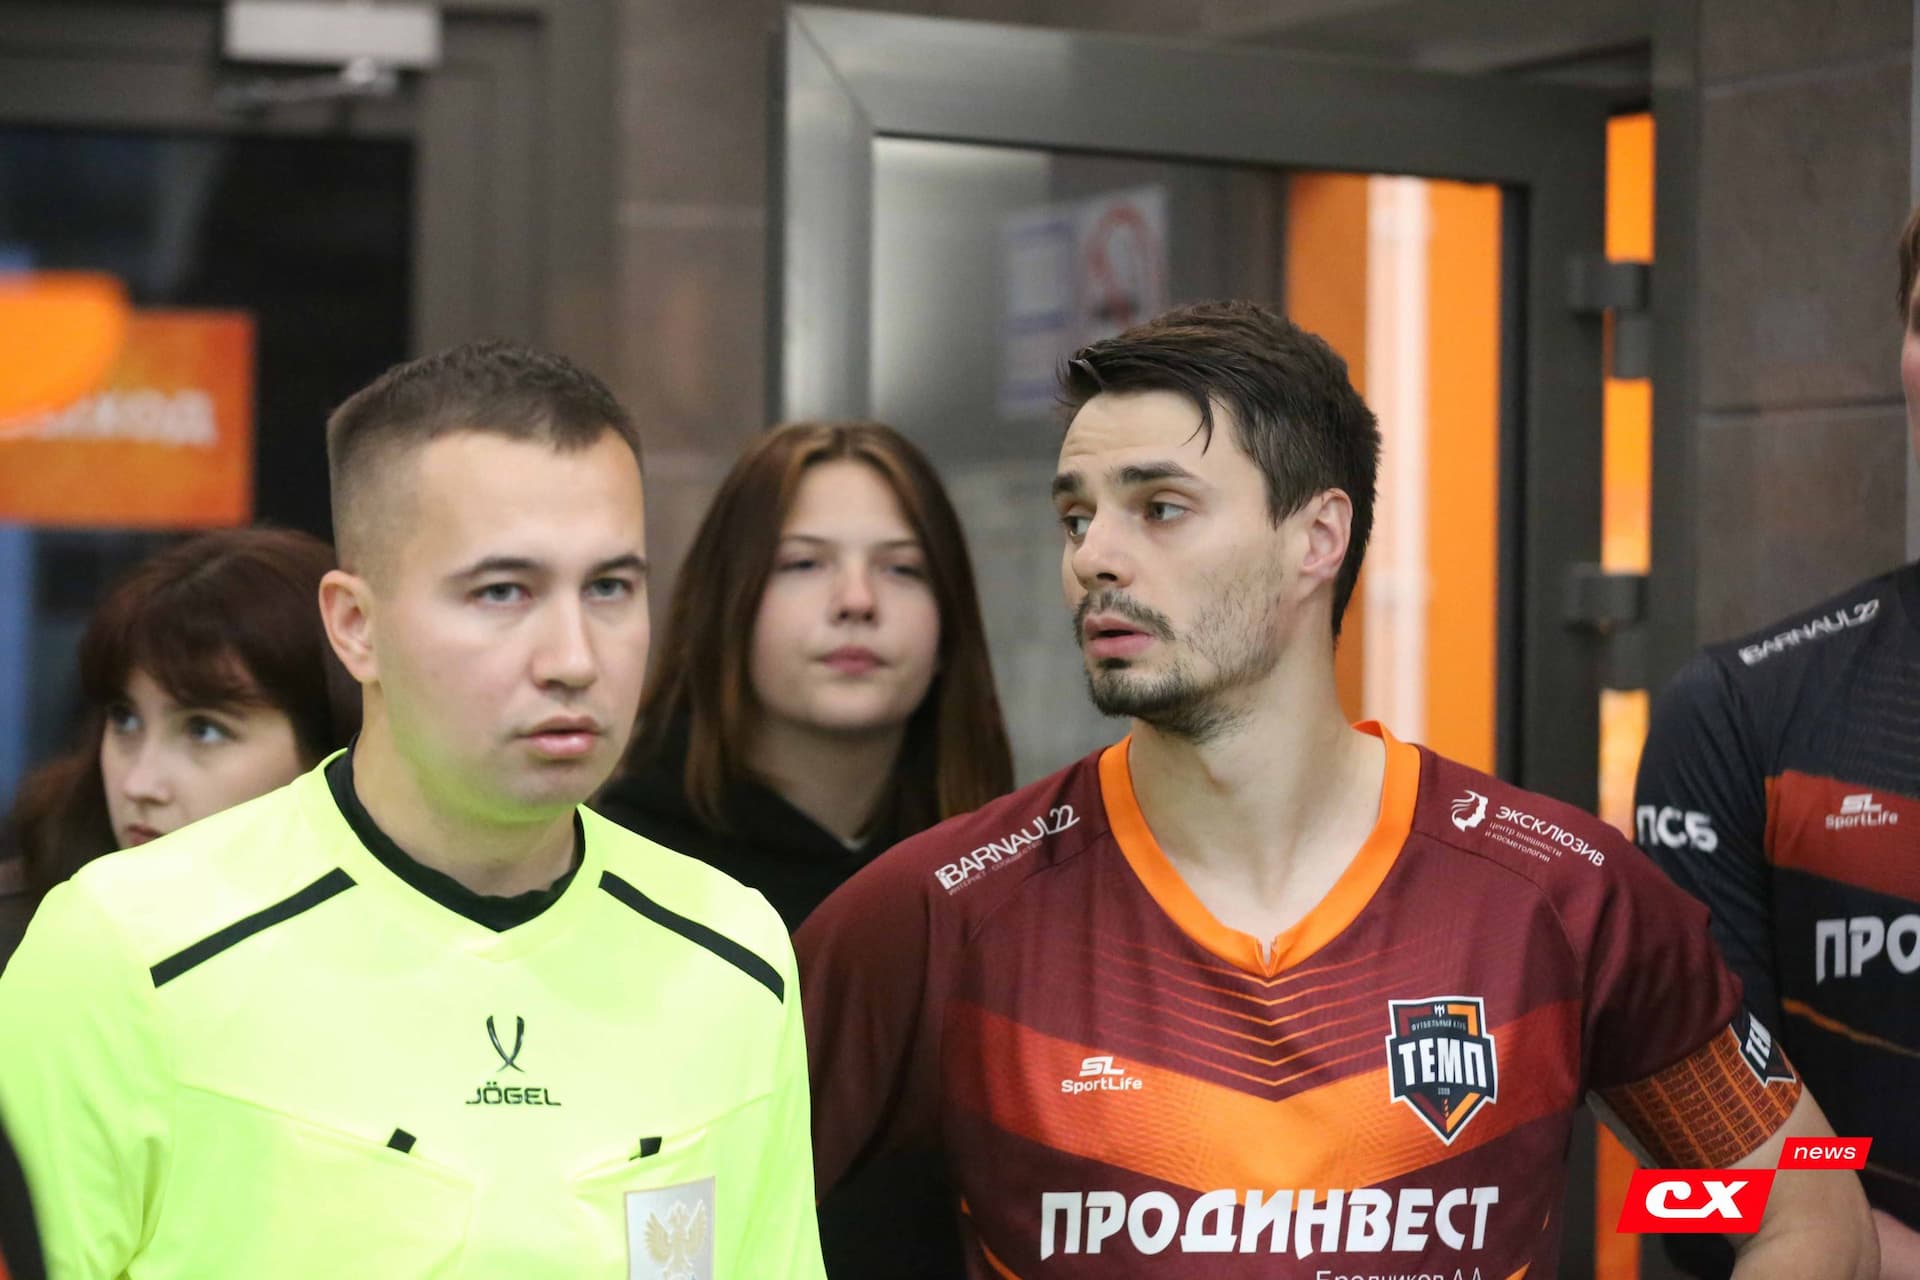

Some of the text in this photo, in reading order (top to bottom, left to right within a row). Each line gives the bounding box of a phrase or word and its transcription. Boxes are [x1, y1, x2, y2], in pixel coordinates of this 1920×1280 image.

[1489, 821, 1562, 857] центр внешности
[1495, 806, 1605, 867] ЭКСКЛЮЗИВ
[1636, 805, 1718, 853] ПСБ
[1825, 811, 1898, 831] SportLife
[935, 805, 1081, 890] BARNAUL22
[1492, 833, 1551, 863] косметологии
[1816, 914, 1920, 985] ПРО
[1079, 1056, 1125, 1077] SL
[1398, 1037, 1488, 1088] ТЕМП
[465, 1081, 562, 1106] JÖGEL
[1061, 1077, 1143, 1095] SportLife
[1041, 1186, 1499, 1260] ПРОДИНВЕСТ
